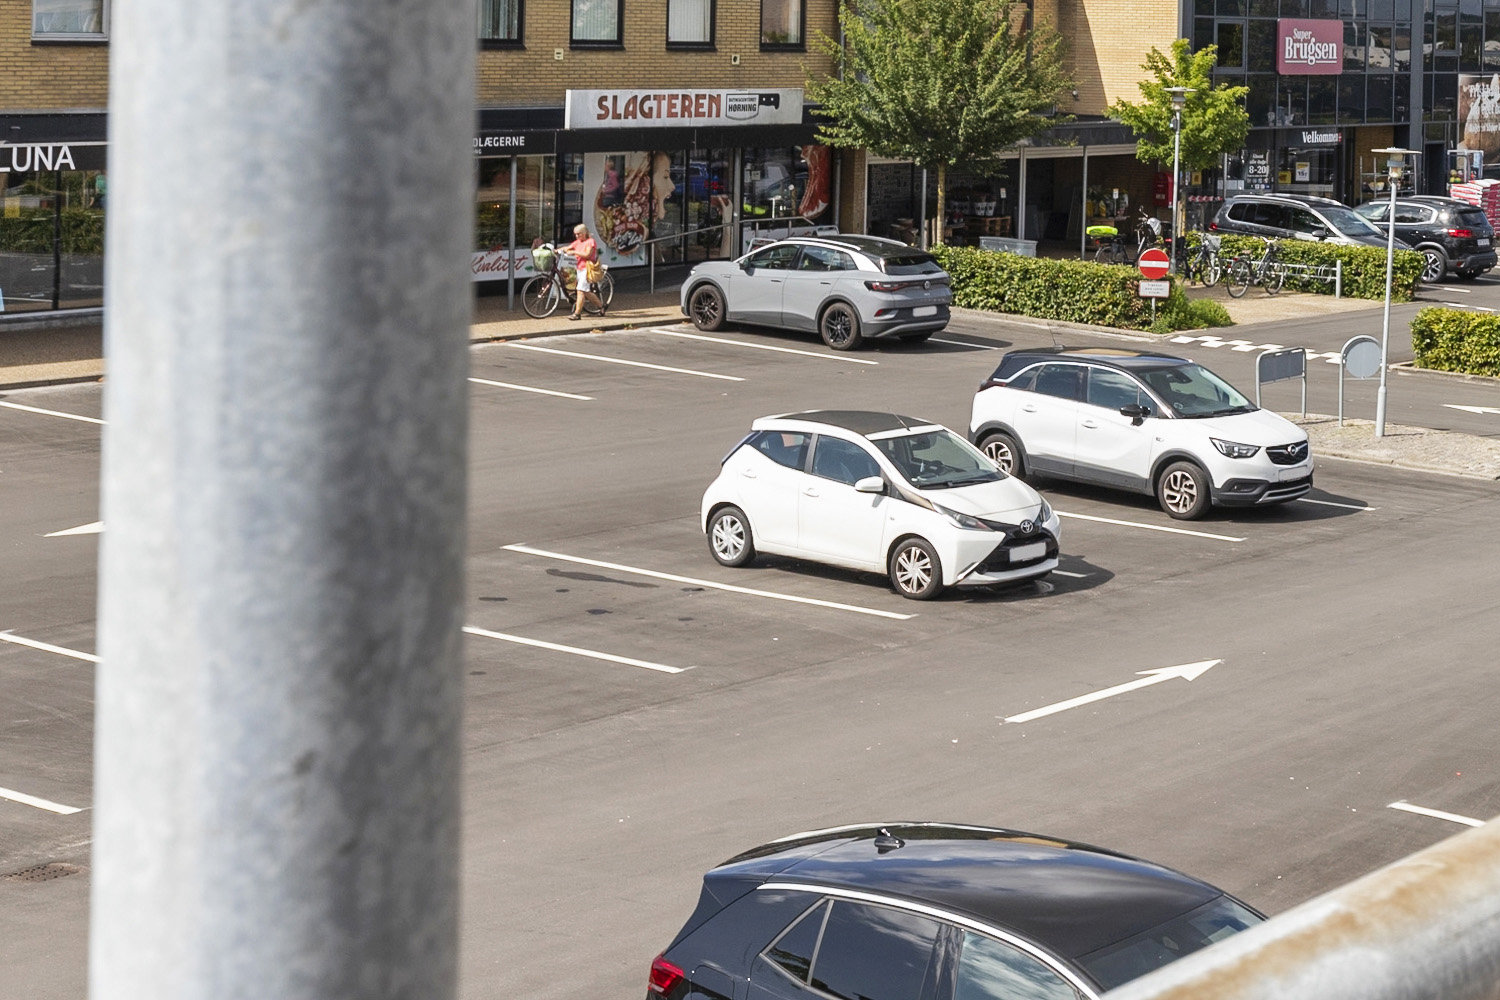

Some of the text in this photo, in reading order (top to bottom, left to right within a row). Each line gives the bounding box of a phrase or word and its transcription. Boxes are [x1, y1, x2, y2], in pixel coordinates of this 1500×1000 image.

[1293, 28, 1312, 41] Super
[1284, 36, 1338, 66] Brugsen
[597, 93, 721, 120] SLAGTEREN
[728, 103, 757, 112] HØRNING
[1302, 130, 1339, 143] Velkommen
[1249, 165, 1266, 174] 8-20
[471, 255, 528, 274] Kvalitt
